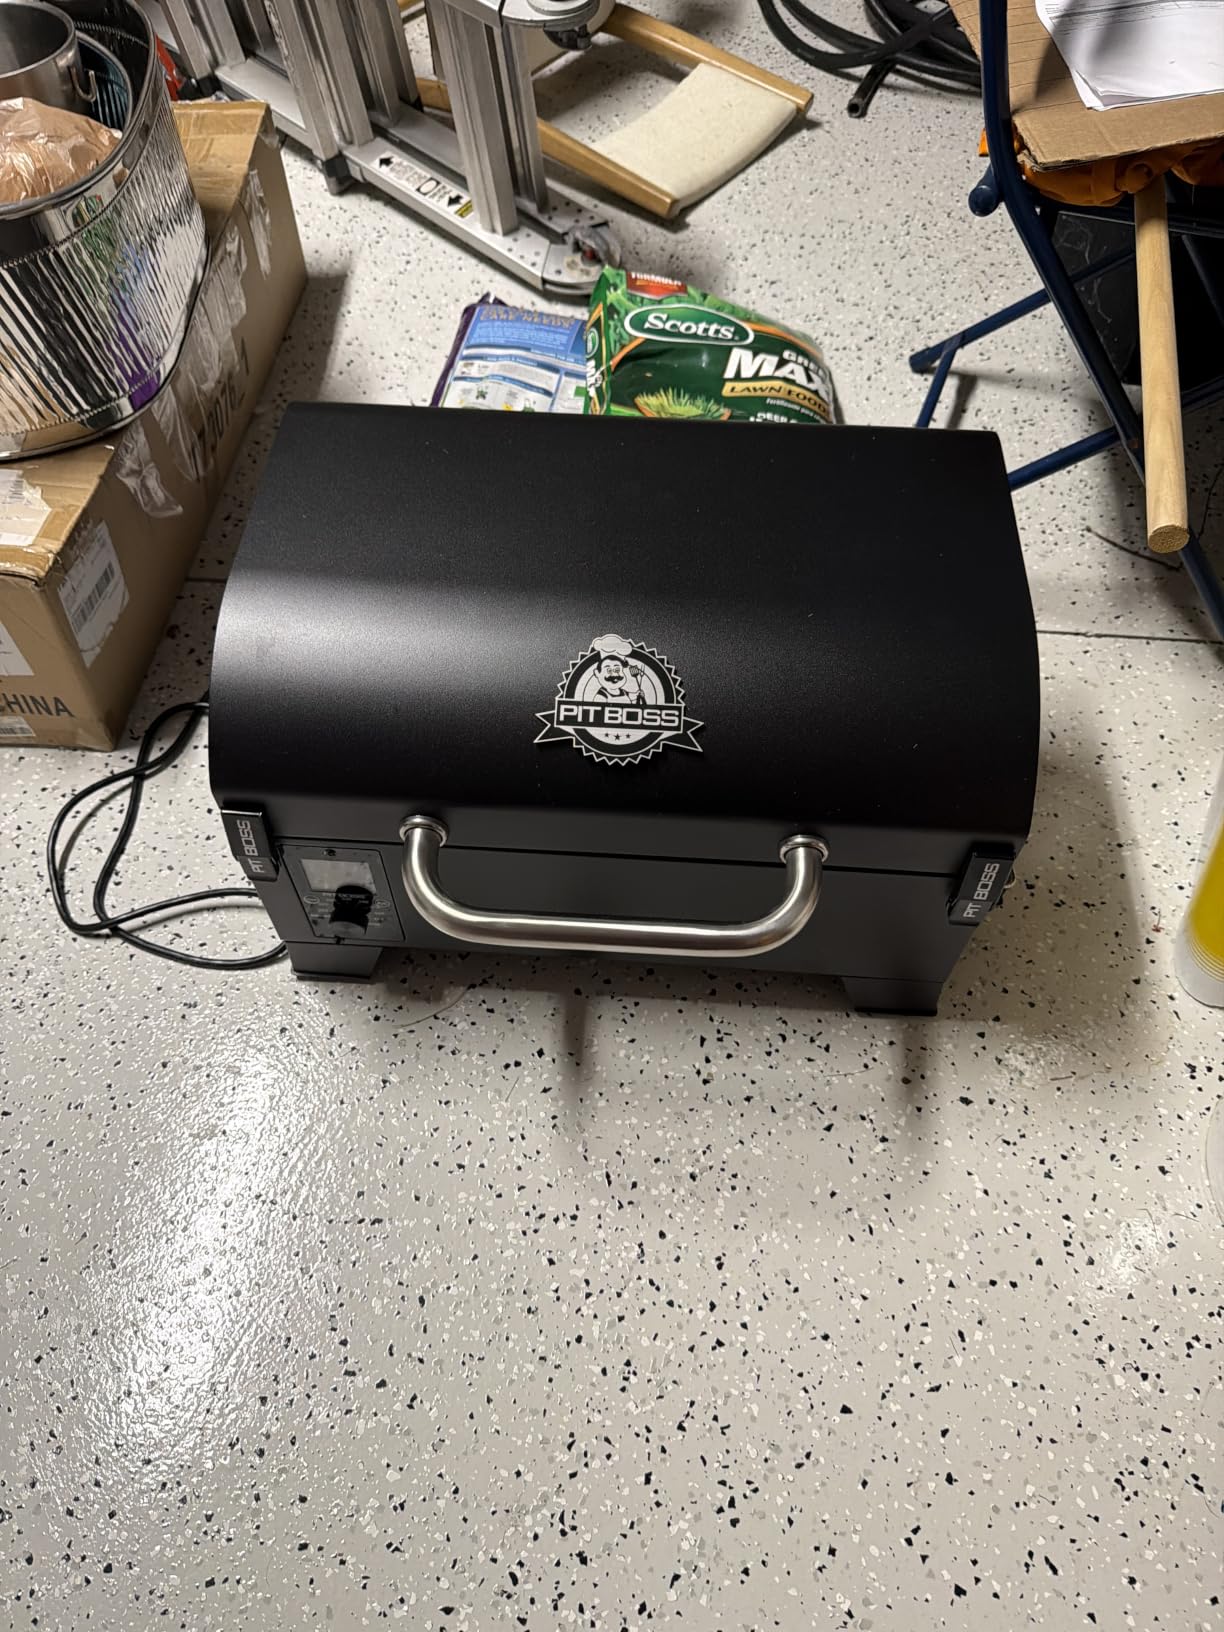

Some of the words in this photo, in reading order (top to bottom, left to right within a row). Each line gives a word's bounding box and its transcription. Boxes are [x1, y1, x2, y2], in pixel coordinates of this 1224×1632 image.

[643, 312, 735, 341] Scotts
[723, 347, 831, 402] MAX
[730, 384, 782, 396] LAWN
[787, 389, 827, 413] FOOD
[559, 704, 602, 722] PIT
[604, 706, 679, 727] BOSS
[237, 819, 259, 856] BOSS
[248, 858, 265, 873] PIT
[963, 902, 981, 918] PIT
[973, 863, 1000, 900] BOSS
